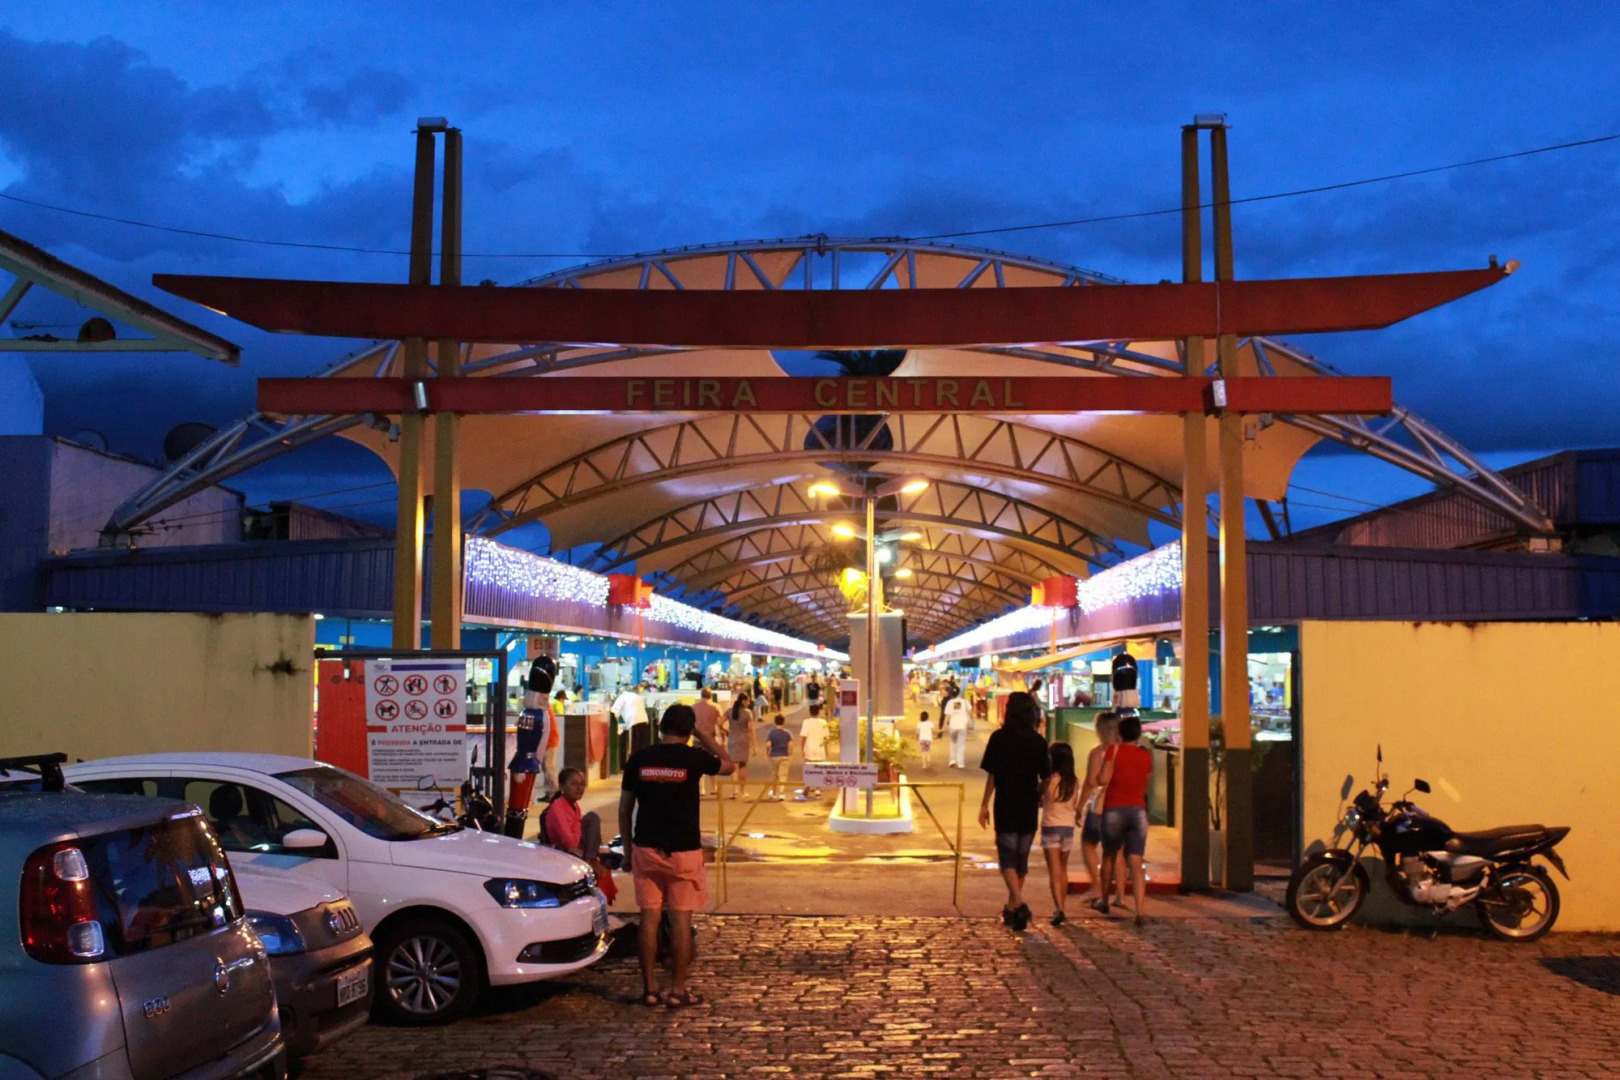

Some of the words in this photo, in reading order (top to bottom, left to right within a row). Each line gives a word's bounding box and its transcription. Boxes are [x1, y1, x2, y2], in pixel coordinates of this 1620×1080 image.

[626, 379, 758, 407] FEIRA
[814, 379, 1026, 408] CENTRAL
[391, 722, 442, 735] ATENÇÃO
